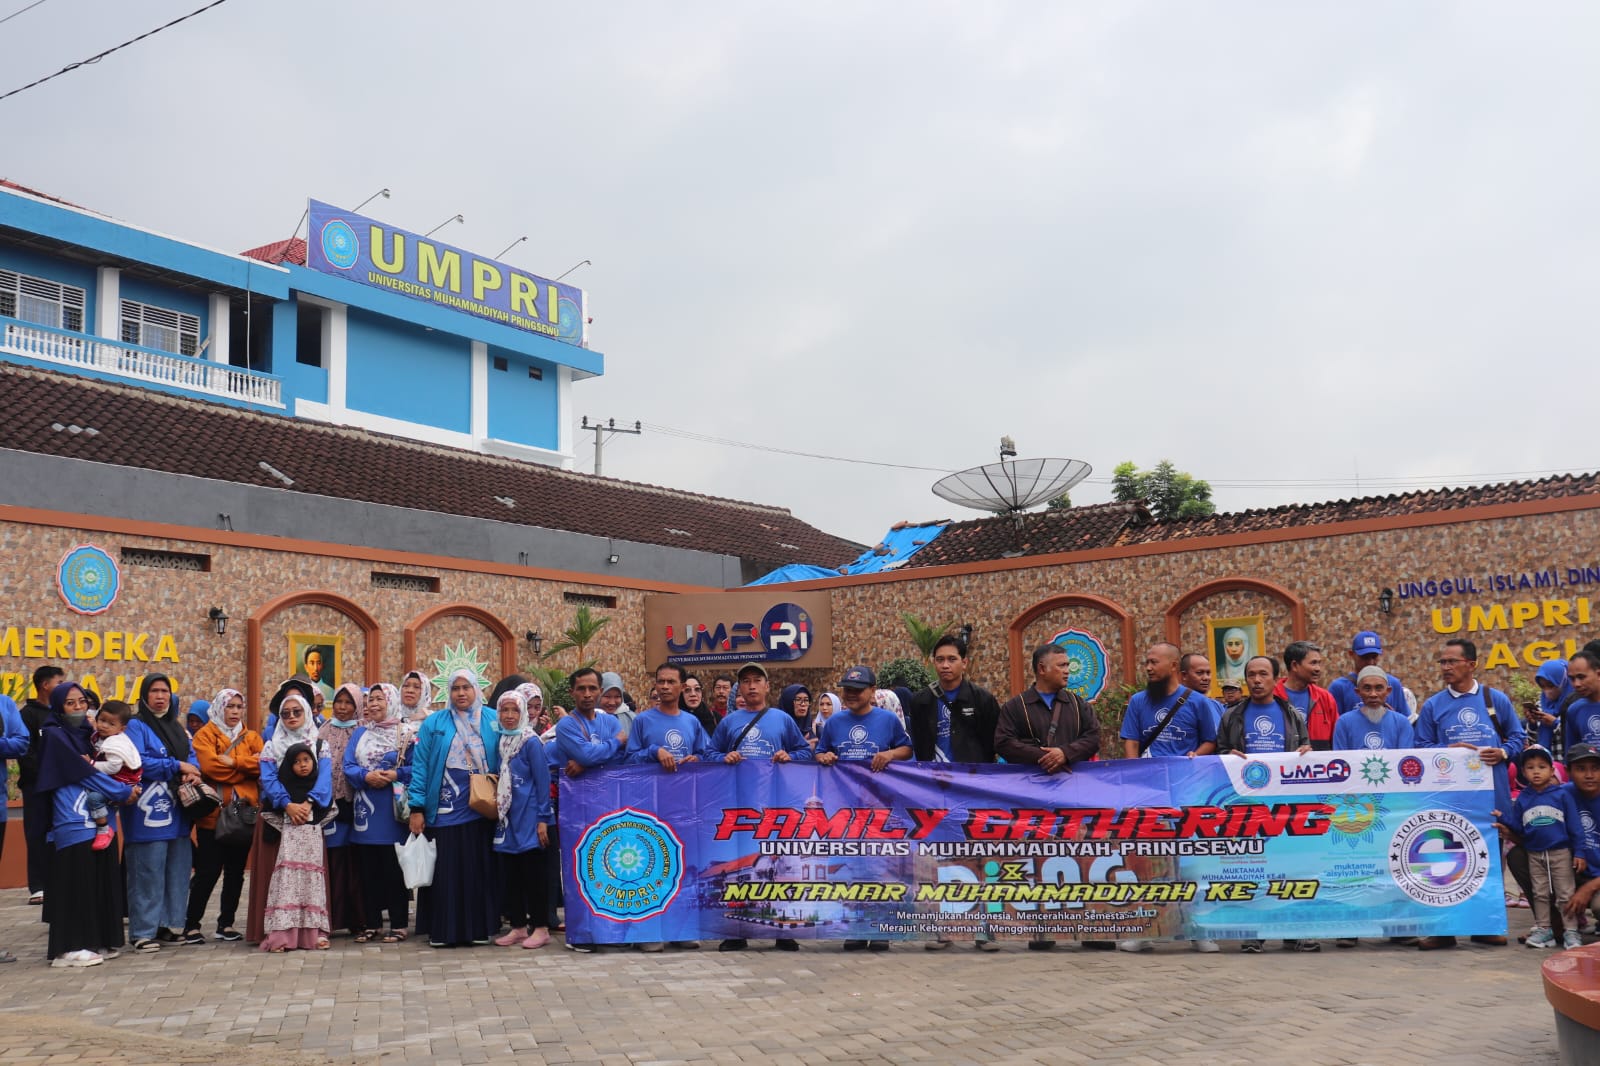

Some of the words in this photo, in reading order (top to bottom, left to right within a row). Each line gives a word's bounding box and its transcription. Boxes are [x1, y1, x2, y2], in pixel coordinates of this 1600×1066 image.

[369, 224, 560, 325] UMPRI
[368, 271, 432, 299] UNIVERSITAS
[433, 291, 510, 322] MUHAMMADIYAH
[511, 314, 560, 337] PRINGSEWU
[1398, 577, 1484, 599] UNGGUL,
[1489, 569, 1564, 592] ISLAMI,
[1431, 597, 1591, 634] UMPRI
[713, 807, 949, 841] FAMILY
[962, 803, 1337, 841] GATHERING
[1440, 812, 1480, 845] TRAVEL
[760, 841, 910, 856] UNIVERSITAS
[919, 841, 1111, 856] MUHAMMADIYAH
[1120, 839, 1265, 856] PRINGSEWU
[600, 895, 658, 908] LAMPUNG
[604, 883, 655, 899] UMPRI
[720, 882, 909, 901] MUKTAMAR
[915, 882, 1198, 901] MUHAMMADIYAH
[1205, 881, 1258, 901] KE
[1266, 879, 1321, 900] 48
[879, 923, 917, 933] Merajut
[919, 924, 986, 933] Kebersamaan,
[989, 923, 1075, 934] Menggembirakan
[1077, 924, 1143, 933] Persaudaraan
[964, 911, 1014, 921] Indonesia,
[1016, 911, 1082, 920] Mencerahkan
[1084, 912, 1125, 920] Semesta
